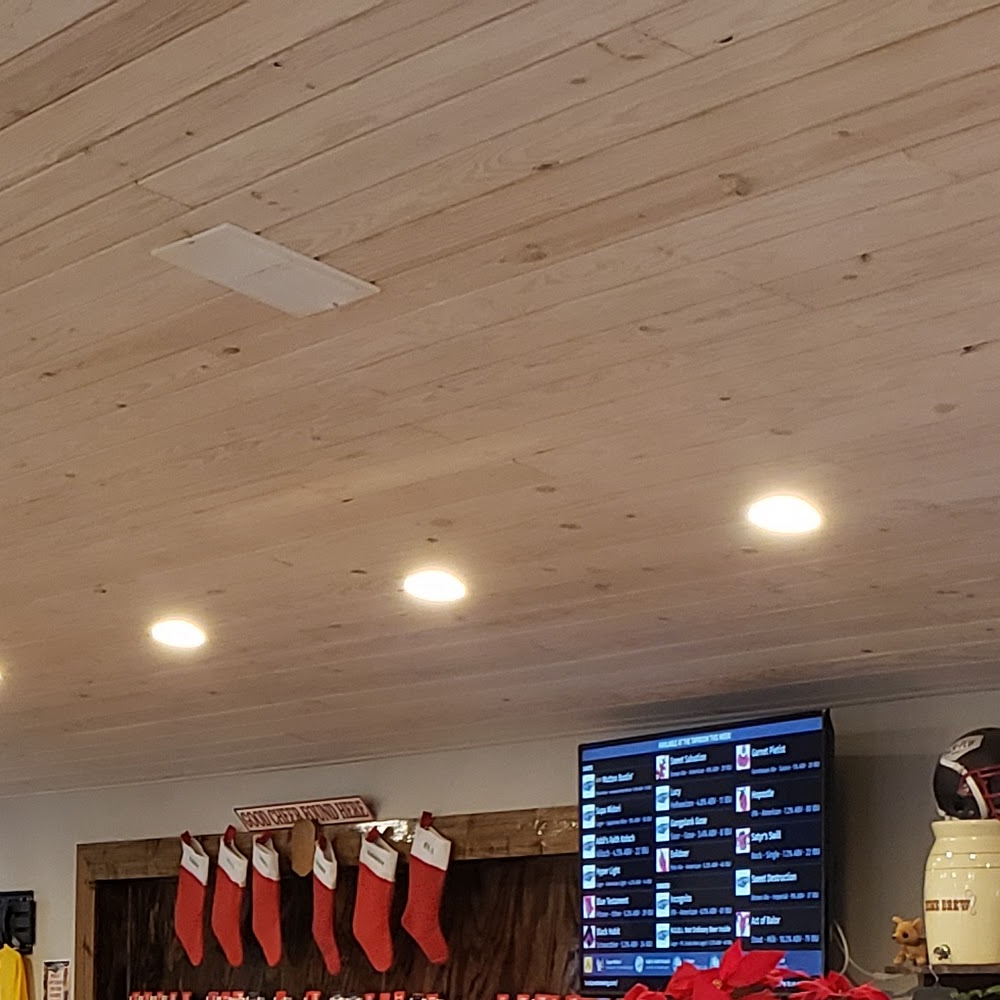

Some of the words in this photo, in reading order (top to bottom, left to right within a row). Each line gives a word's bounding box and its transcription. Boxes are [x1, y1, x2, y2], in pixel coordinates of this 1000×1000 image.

[240, 810, 271, 828] GOOD
[268, 807, 302, 825] CHEER
[300, 803, 339, 821] FOUND
[334, 801, 369, 819] HERE
